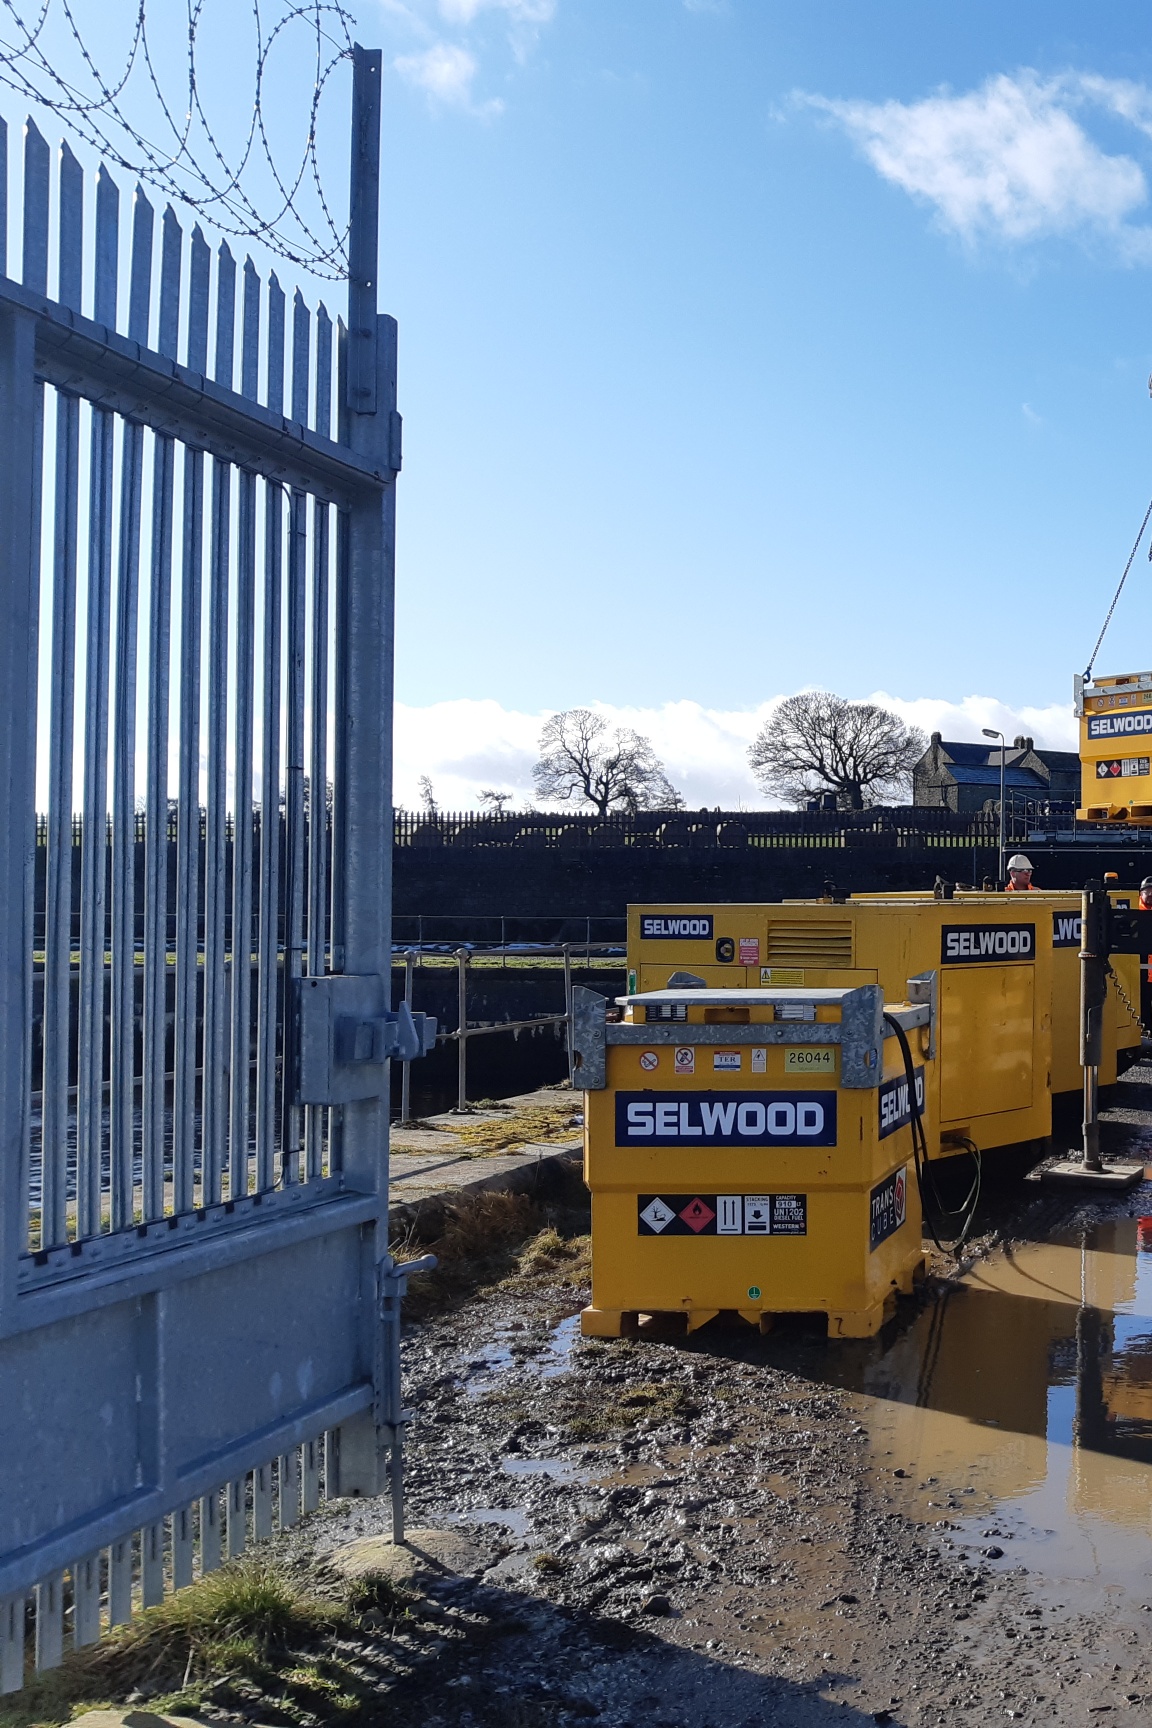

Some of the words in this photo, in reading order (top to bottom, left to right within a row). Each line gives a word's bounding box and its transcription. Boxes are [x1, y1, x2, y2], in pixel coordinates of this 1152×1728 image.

[1091, 714, 1152, 735] SELWOOD
[644, 919, 710, 935] SELWOOD
[946, 930, 1031, 957] SELWOOD
[789, 1052, 830, 1063] 26044
[881, 1076, 923, 1128] SELWD
[627, 1102, 825, 1136] SELWOOD
[774, 1208, 804, 1216] UN1202
[872, 1185, 894, 1220] TRANS
[872, 1206, 894, 1241] CUBE
